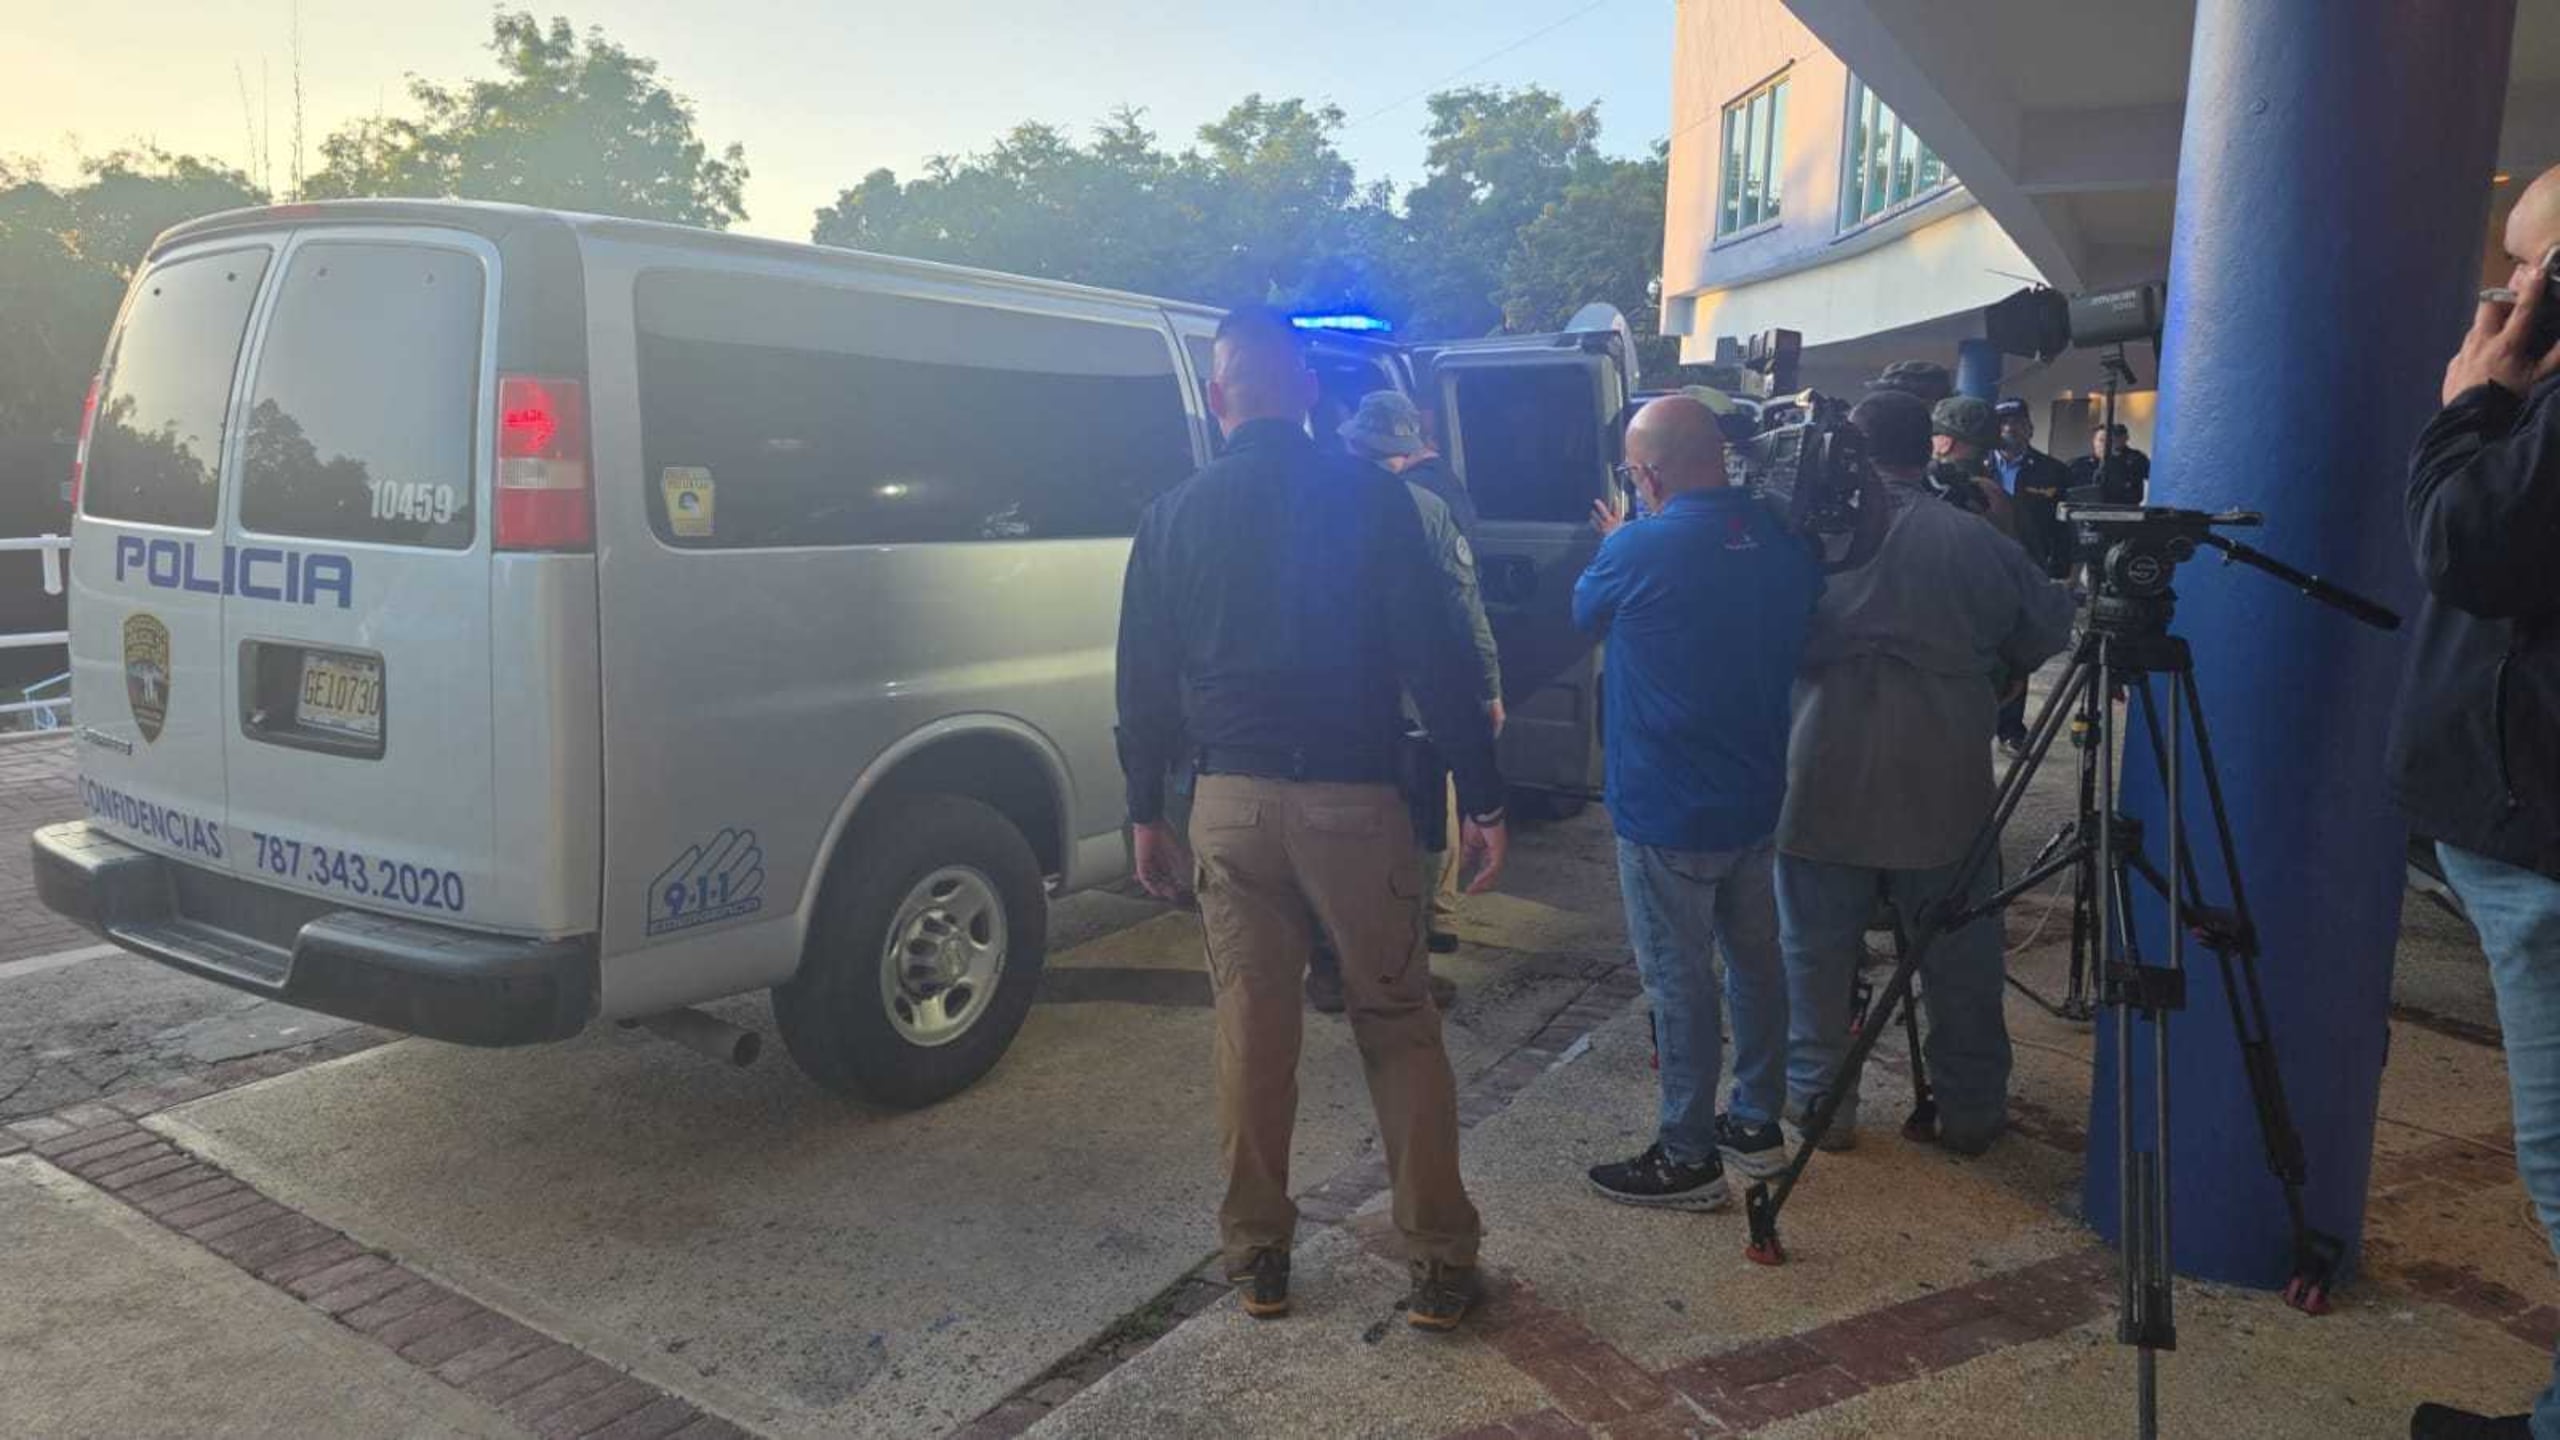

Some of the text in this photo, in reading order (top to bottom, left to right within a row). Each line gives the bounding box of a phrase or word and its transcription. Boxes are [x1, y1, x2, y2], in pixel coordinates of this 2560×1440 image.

[369, 479, 454, 525] 10459
[116, 534, 352, 609] POLICIA
[78, 773, 464, 911] CONFIDENCIAS 787.343.2020
